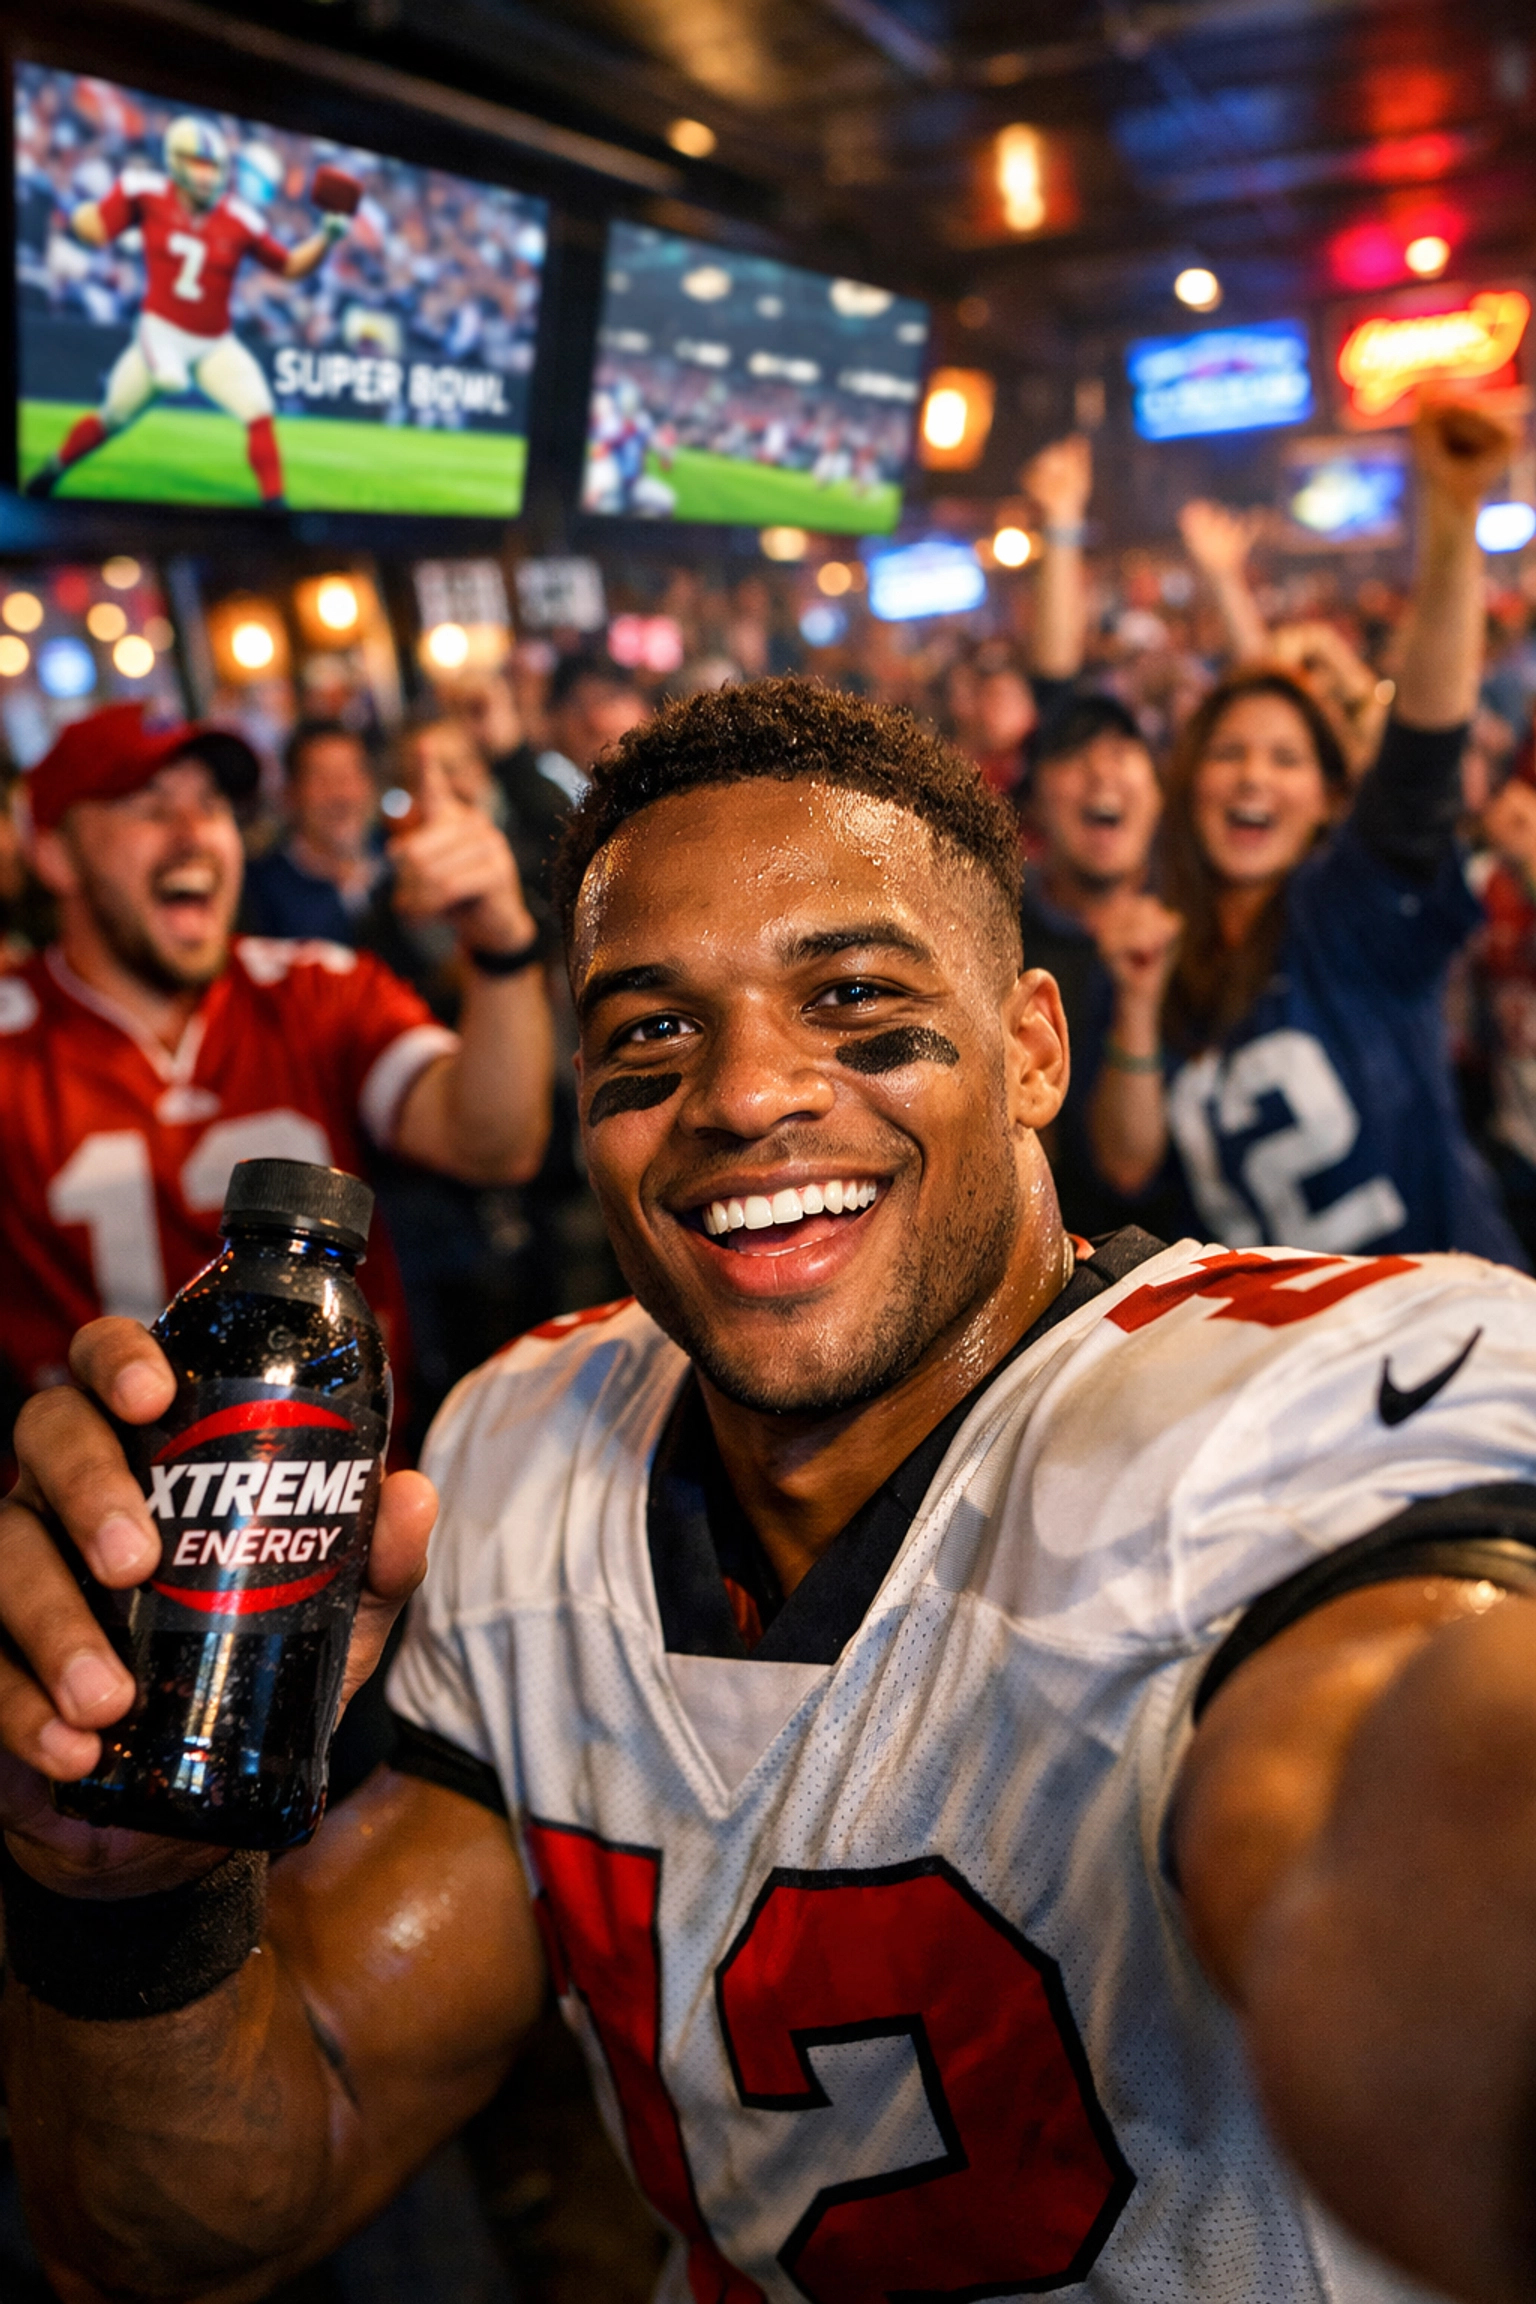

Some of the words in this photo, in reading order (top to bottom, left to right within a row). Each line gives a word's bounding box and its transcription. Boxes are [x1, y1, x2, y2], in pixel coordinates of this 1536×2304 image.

[167, 232, 207, 301] 7
[274, 348, 404, 404] SUPER
[408, 363, 510, 416] BOWL
[147, 1459, 374, 1519] XTREME
[172, 1526, 342, 1567] ENERGY
[528, 1817, 1138, 2304] 12
